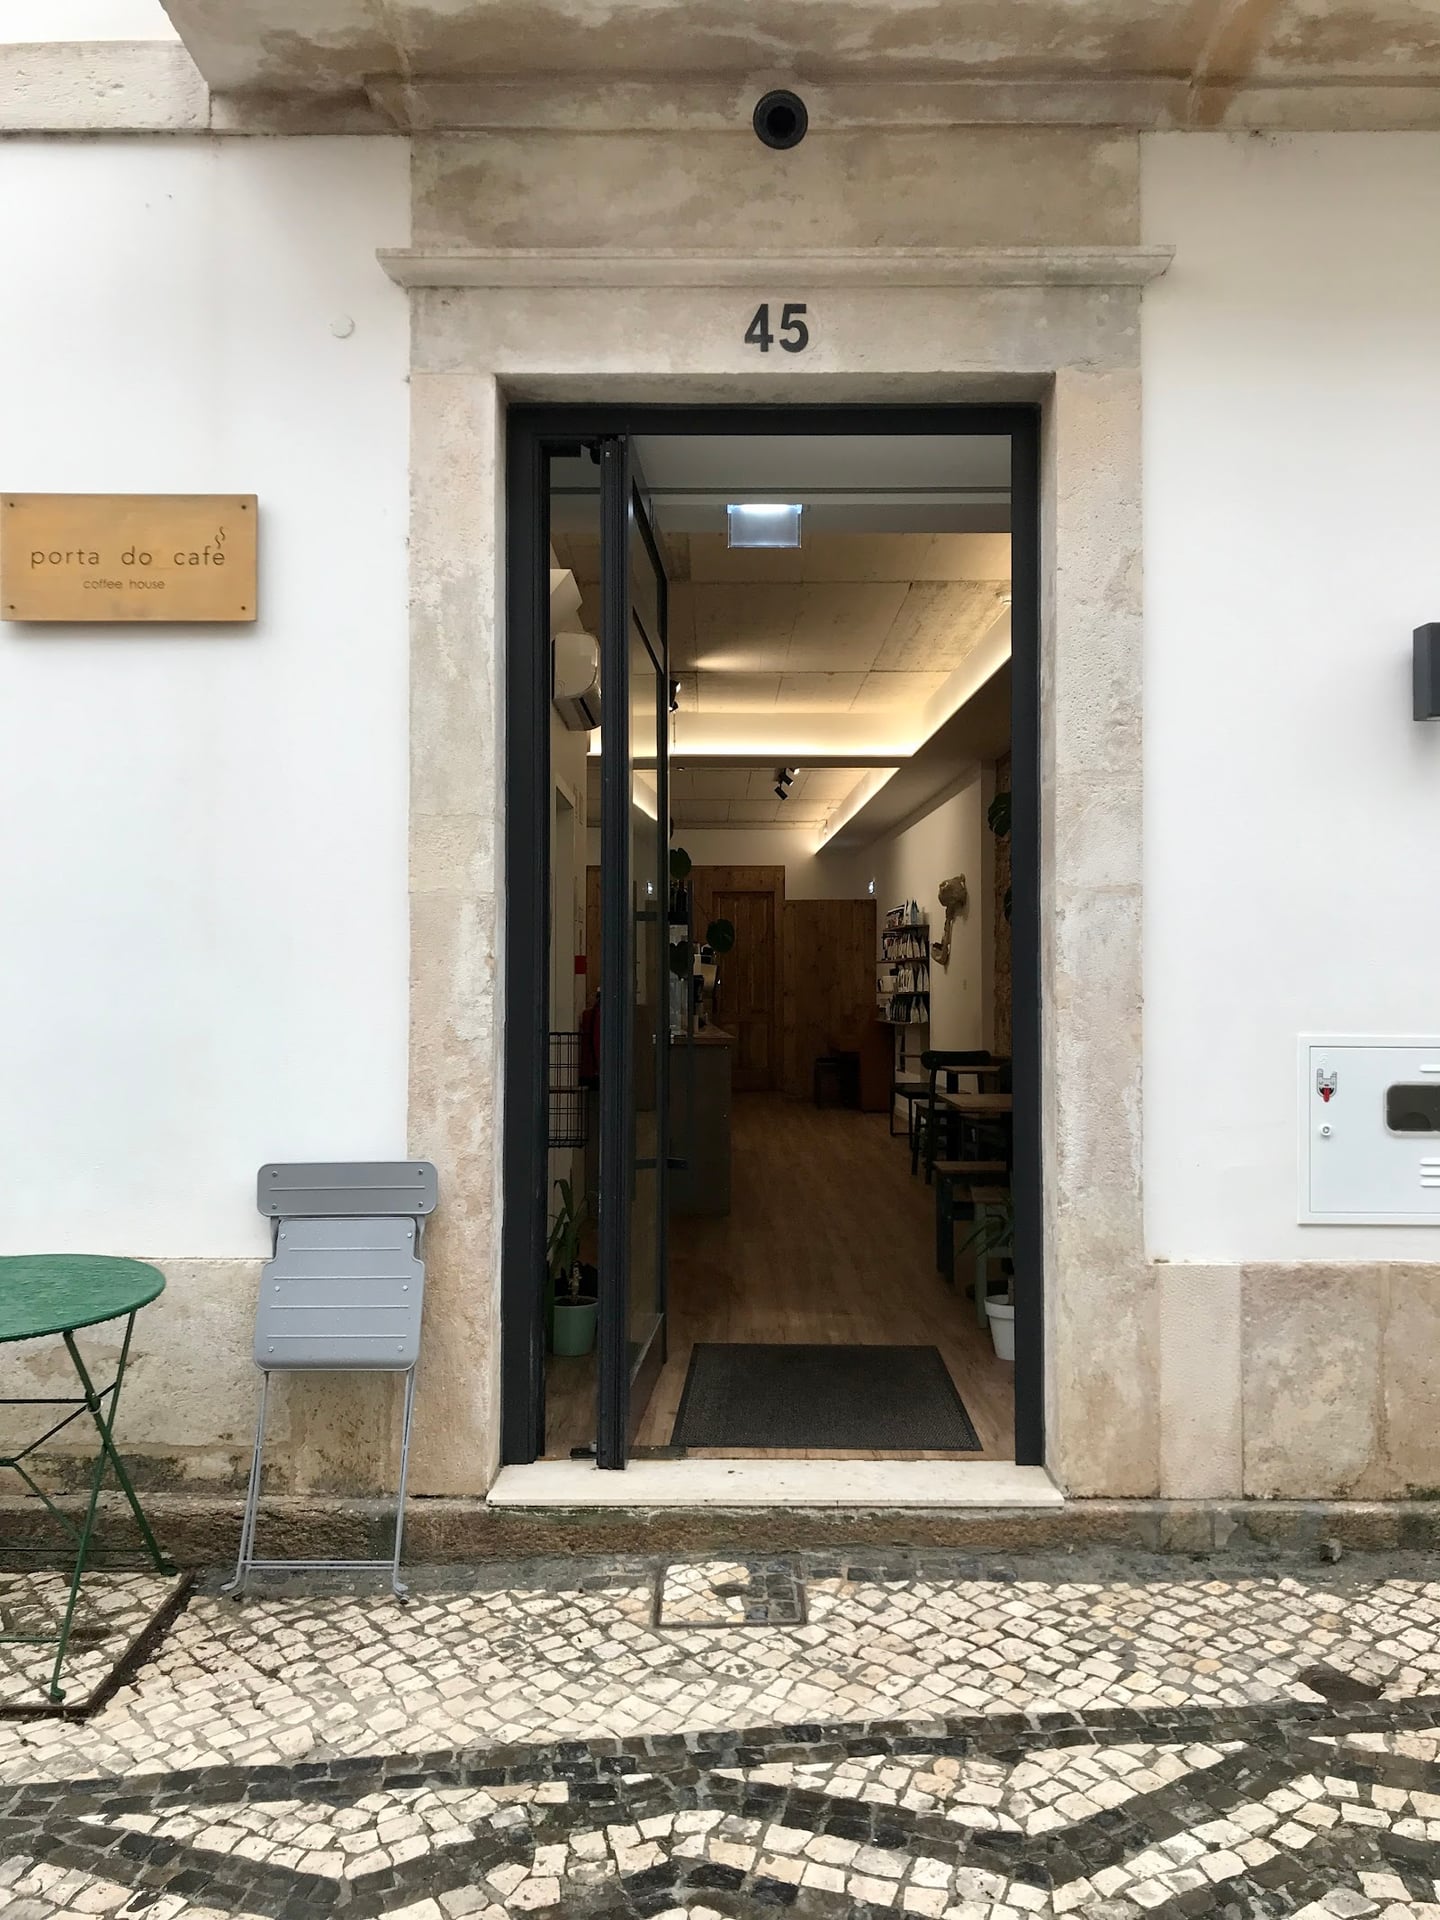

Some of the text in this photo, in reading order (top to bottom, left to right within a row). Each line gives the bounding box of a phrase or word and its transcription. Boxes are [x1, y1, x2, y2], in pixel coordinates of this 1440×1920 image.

[744, 303, 809, 353] 45
[31, 548, 100, 570] porta
[121, 545, 153, 566] do
[83, 579, 166, 590] coffee house
